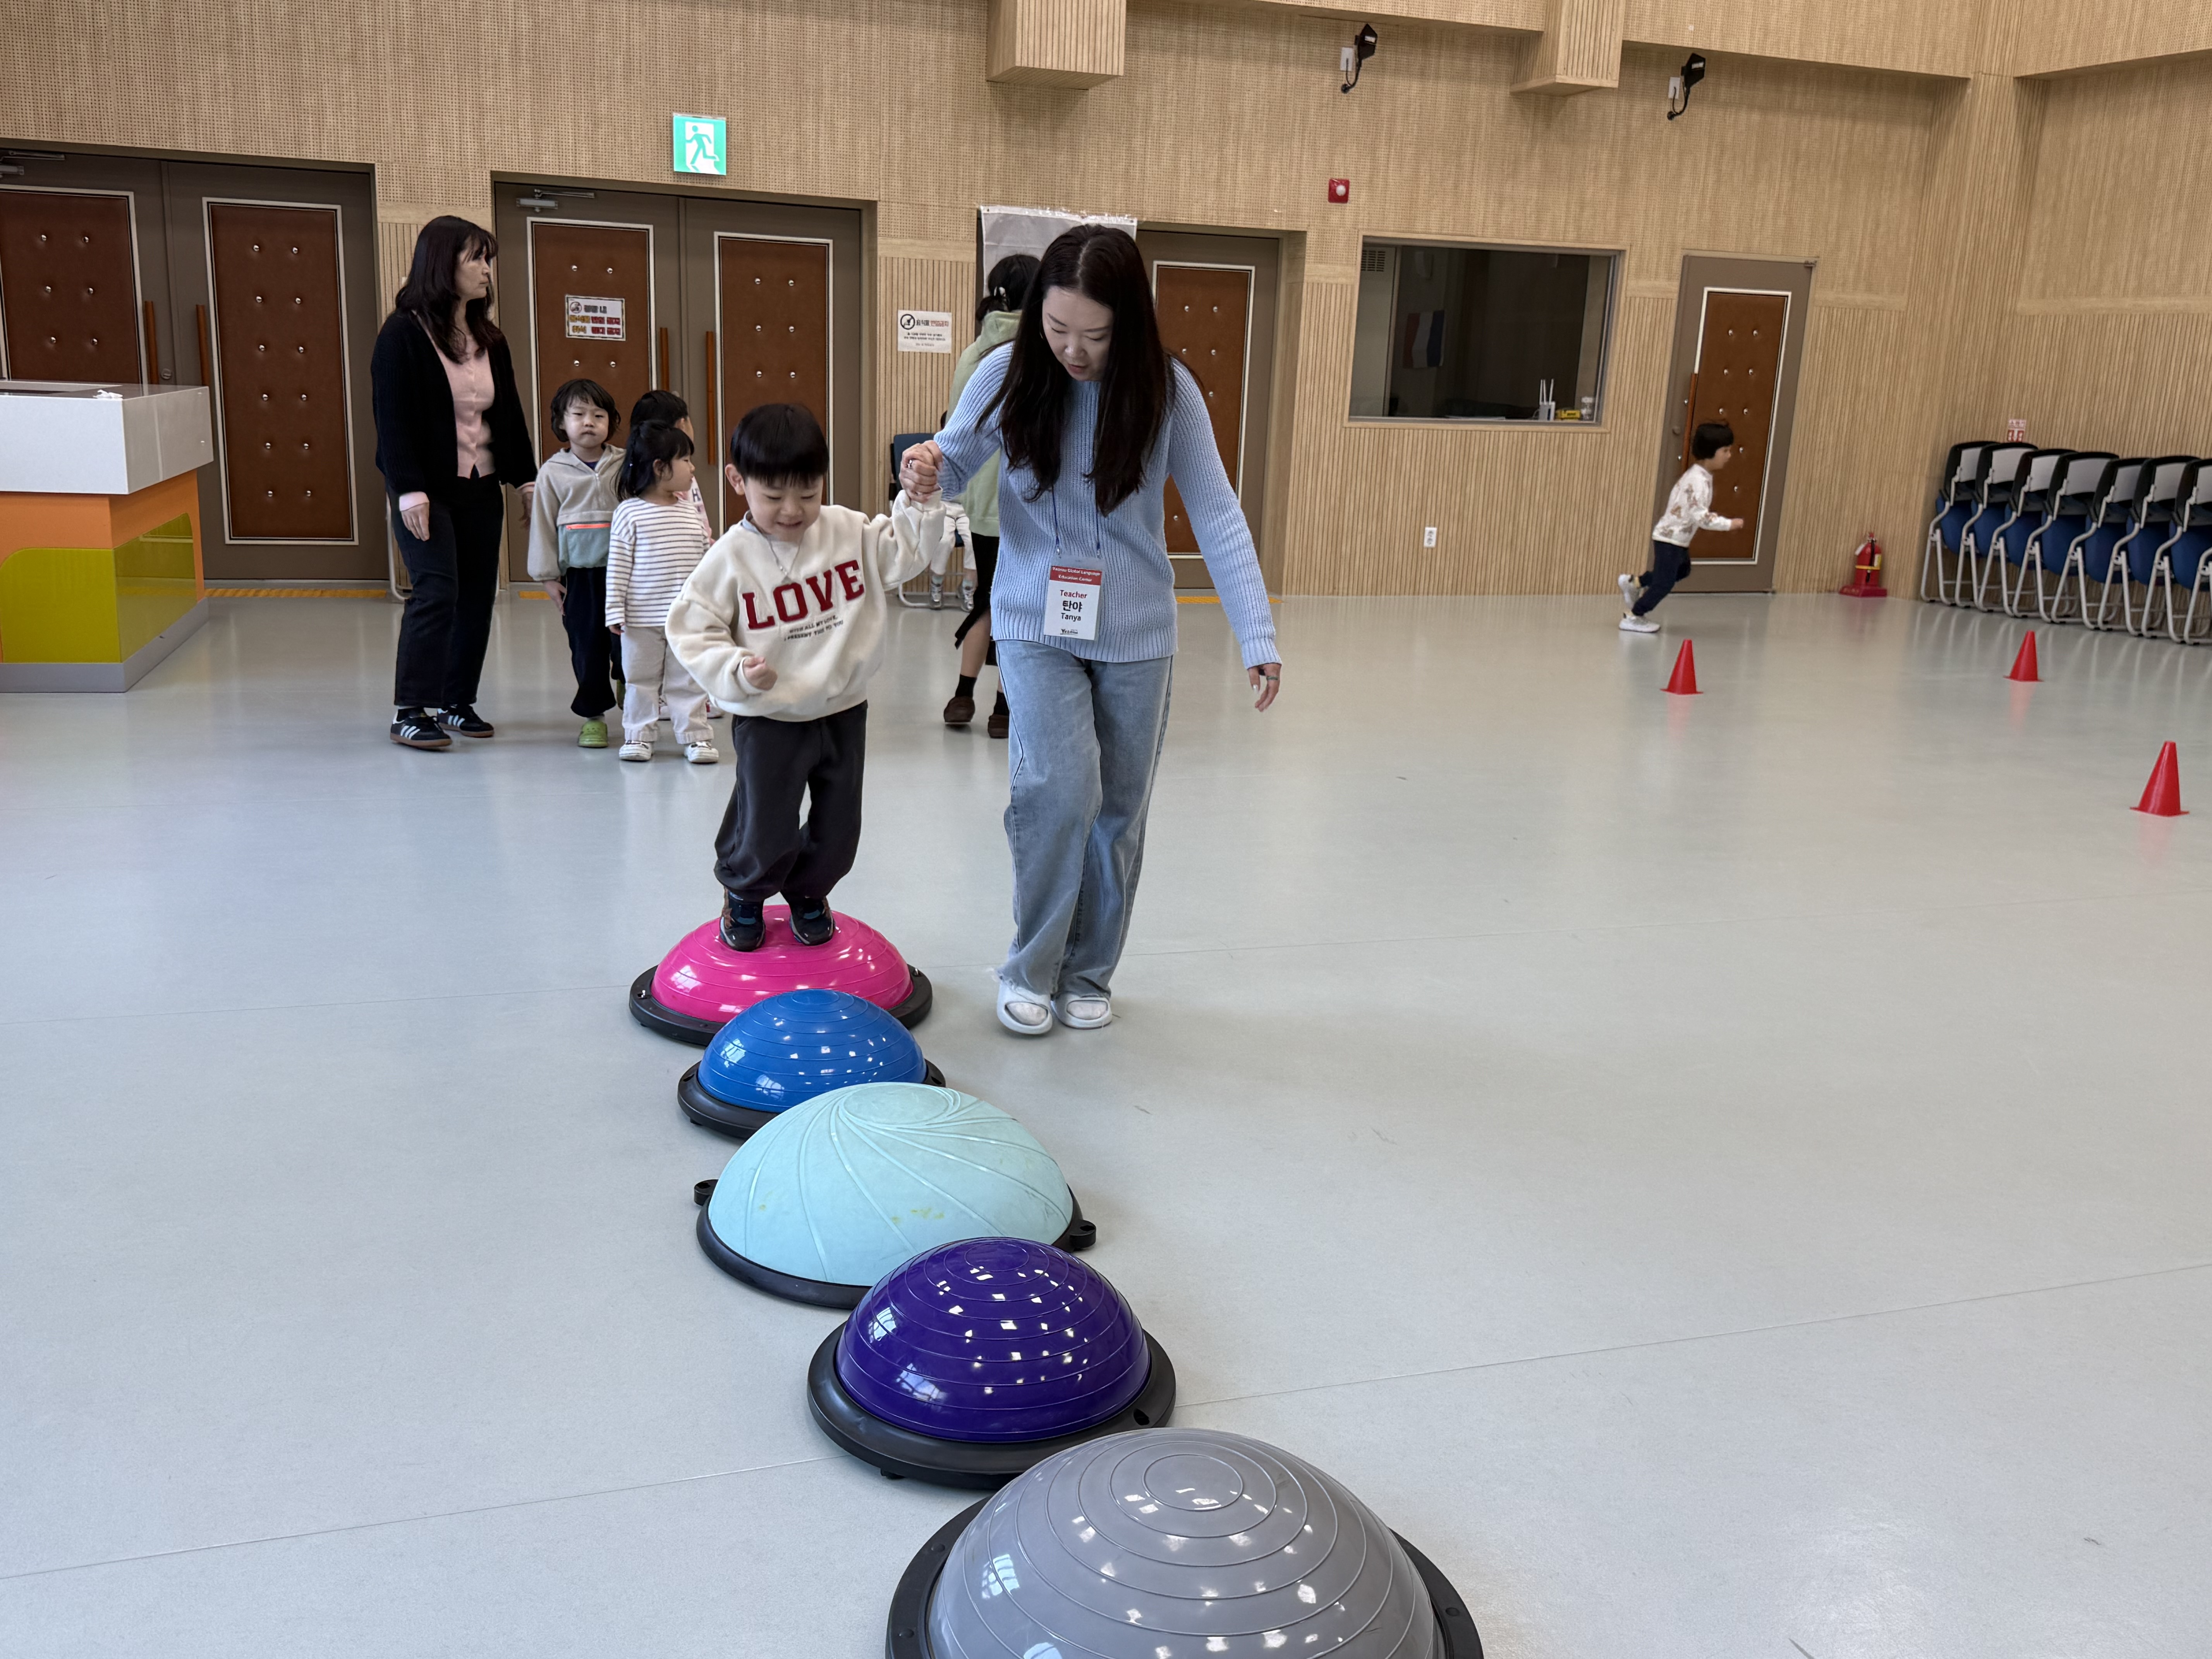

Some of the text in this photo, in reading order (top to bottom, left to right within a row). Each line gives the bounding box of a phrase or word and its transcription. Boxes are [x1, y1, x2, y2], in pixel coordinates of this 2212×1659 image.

[742, 560, 865, 630] LOVE
[1060, 590, 1087, 598] Teacher
[1063, 601, 1082, 612] 탄야
[1061, 613, 1081, 622] Tanya
